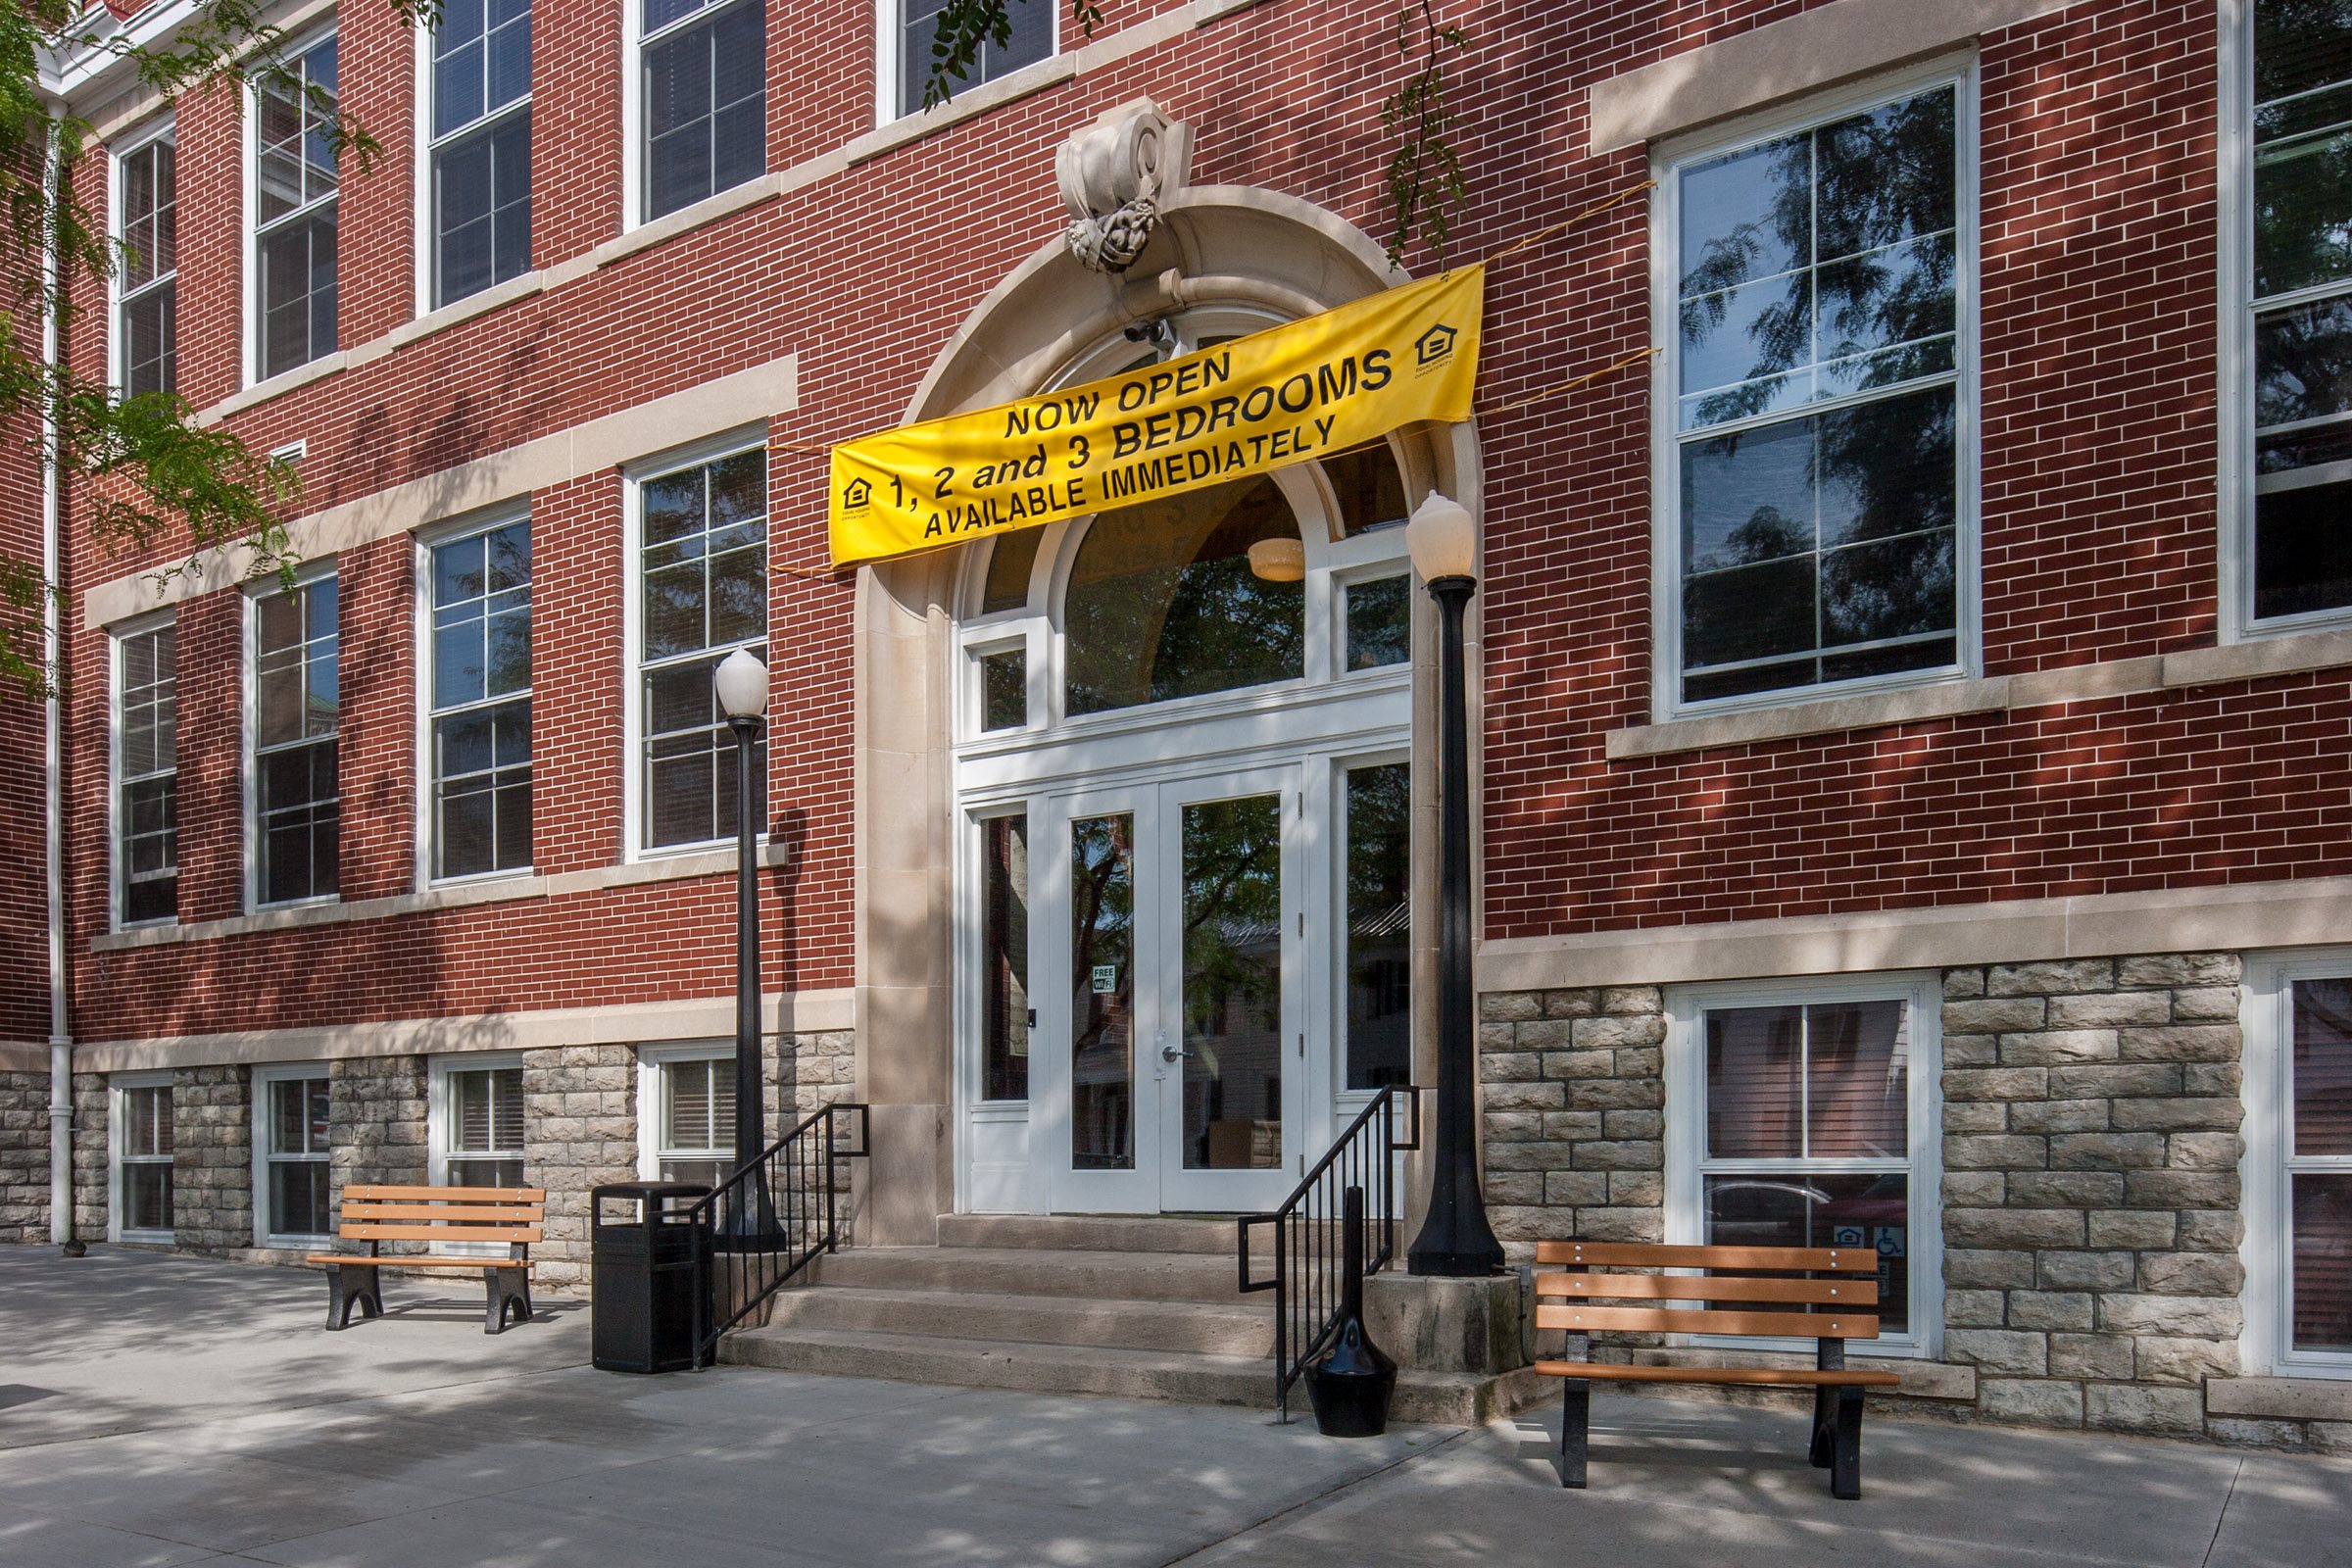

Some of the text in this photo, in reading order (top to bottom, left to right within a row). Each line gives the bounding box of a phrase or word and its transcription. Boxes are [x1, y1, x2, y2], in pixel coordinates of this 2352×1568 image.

[890, 349, 1393, 513] 1, 2 and 3 BEDROOMS
[1004, 352, 1231, 438] NOW OPEN
[924, 476, 1087, 539] AVAILABLE
[1102, 415, 1336, 500] IMMEDIATELY
[1094, 967, 1114, 978] FREE
